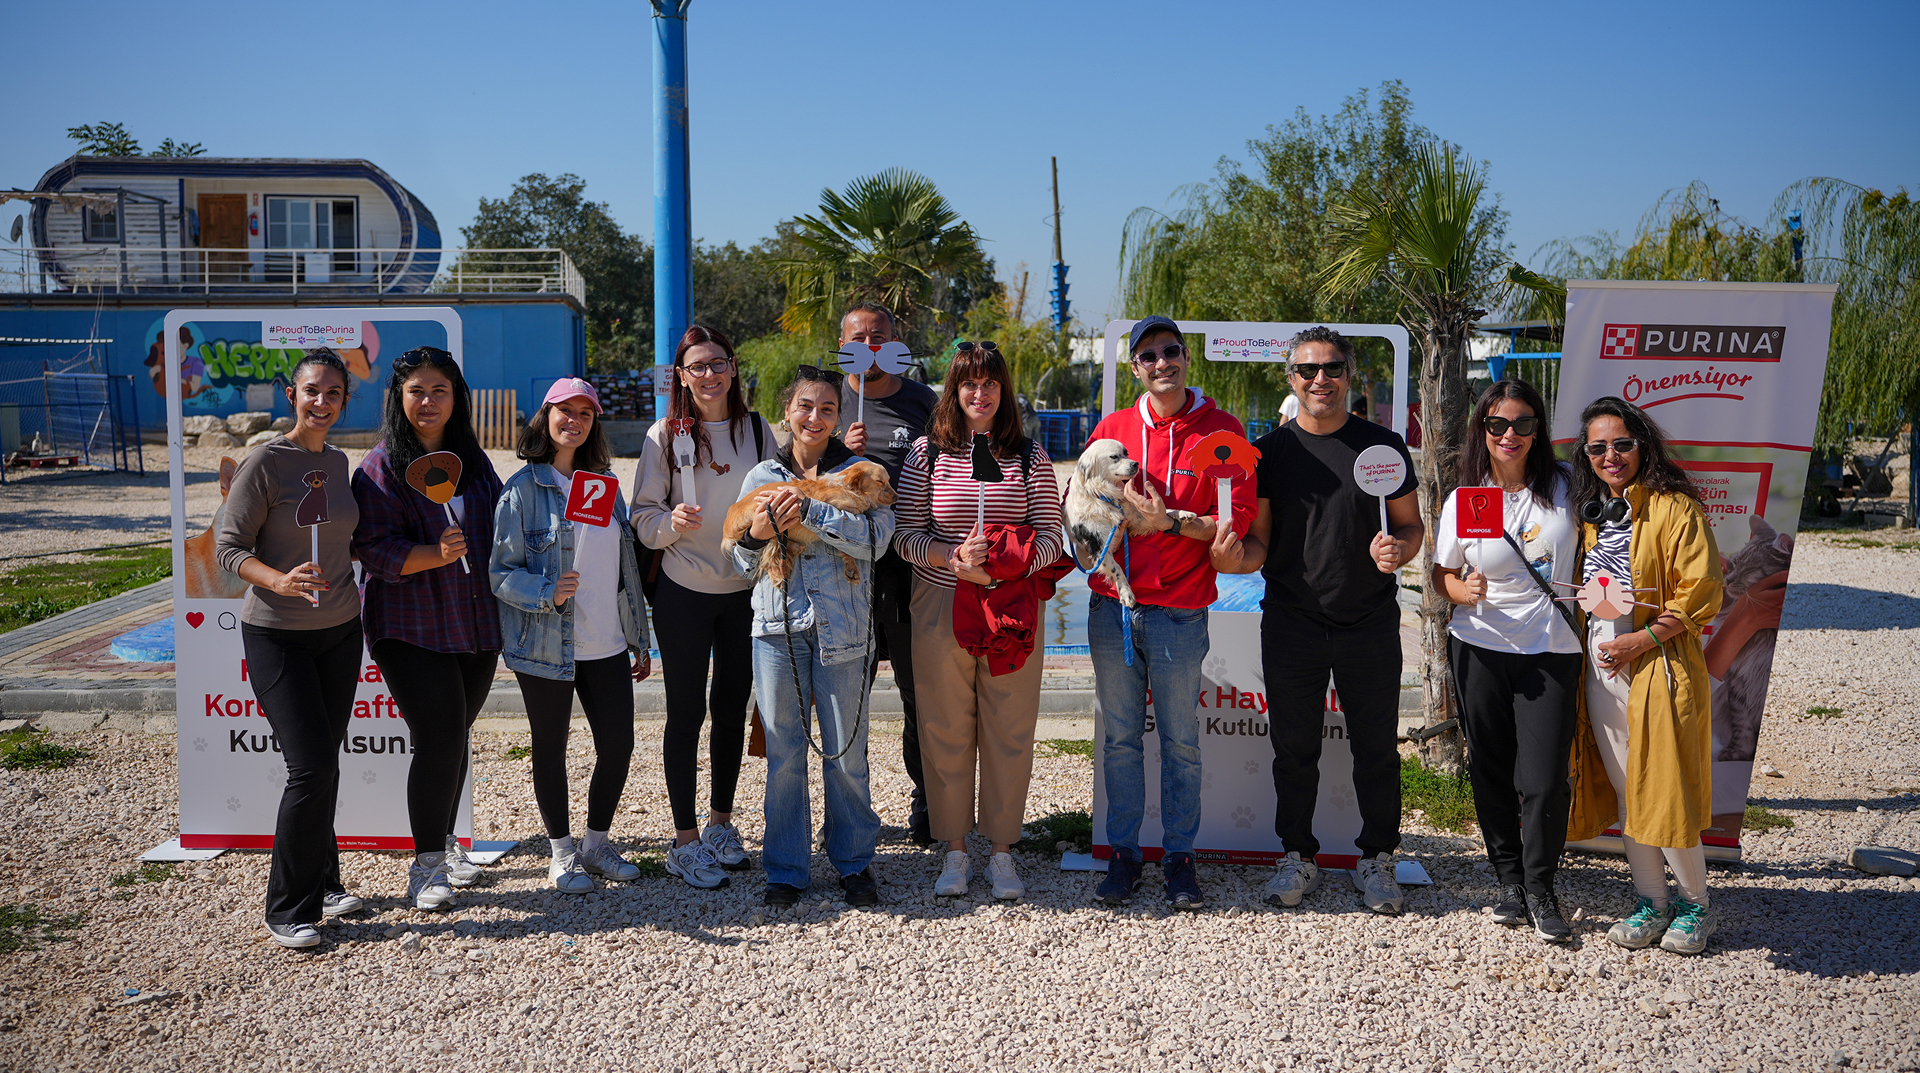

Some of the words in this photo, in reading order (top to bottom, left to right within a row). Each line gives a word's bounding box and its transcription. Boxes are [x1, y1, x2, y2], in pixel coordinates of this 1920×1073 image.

[269, 325, 355, 334] #ProudToBePurina
[1212, 338, 1292, 347] #ProudToBePuri
[1622, 366, 1752, 402] Önemsiyor
[1175, 469, 1195, 477] PURIN
[1699, 487, 1728, 501] ğün
[1702, 503, 1748, 515] aması
[572, 511, 603, 521] PIONEERING
[1206, 717, 1268, 736] Kutlu
